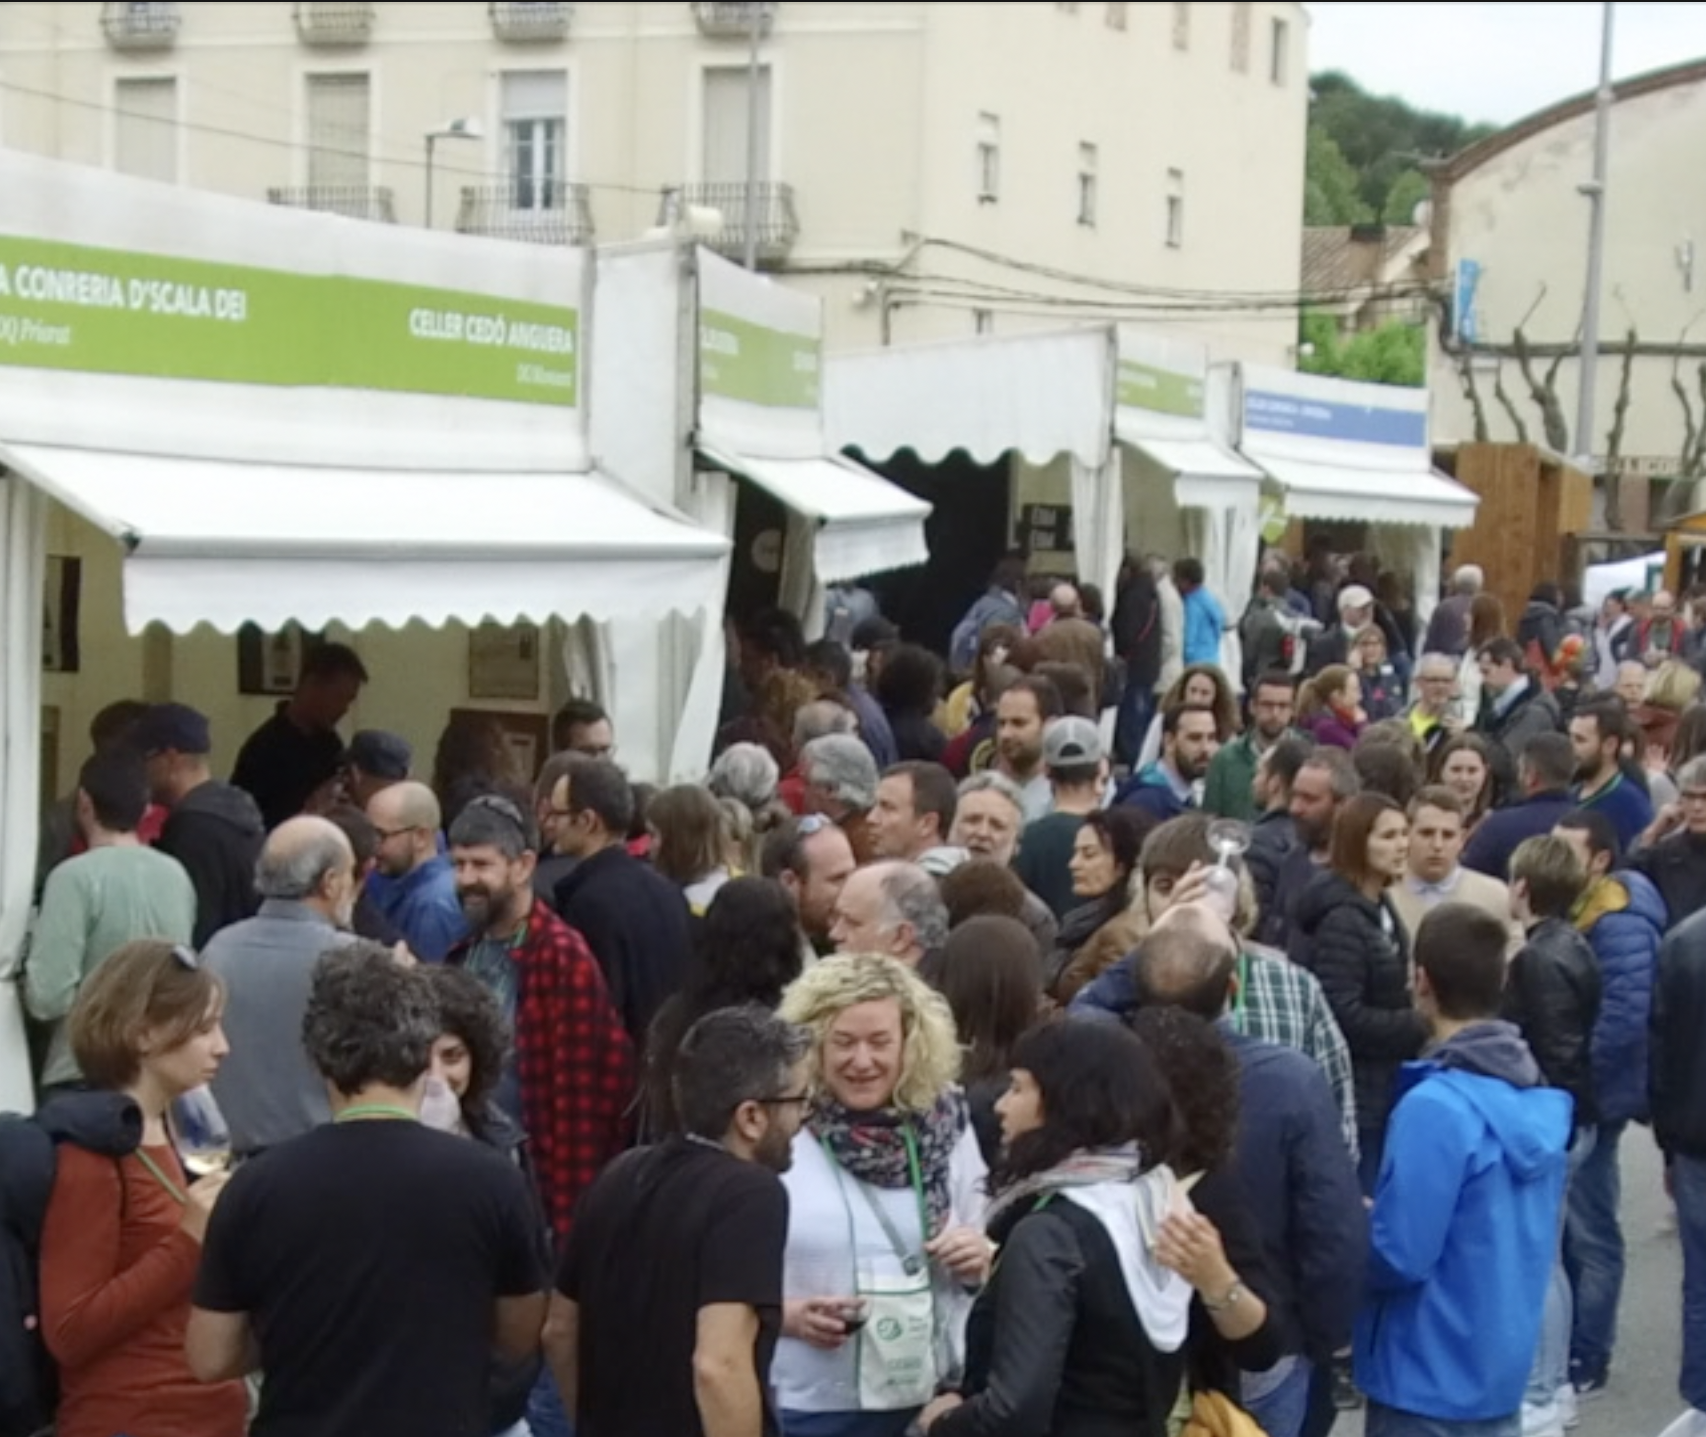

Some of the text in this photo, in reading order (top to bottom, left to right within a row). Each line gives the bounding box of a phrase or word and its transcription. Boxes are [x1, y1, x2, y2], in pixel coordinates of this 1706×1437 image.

[15, 264, 125, 308] CONRERIA
[214, 287, 247, 321] DEI
[409, 306, 463, 342] CELLER
